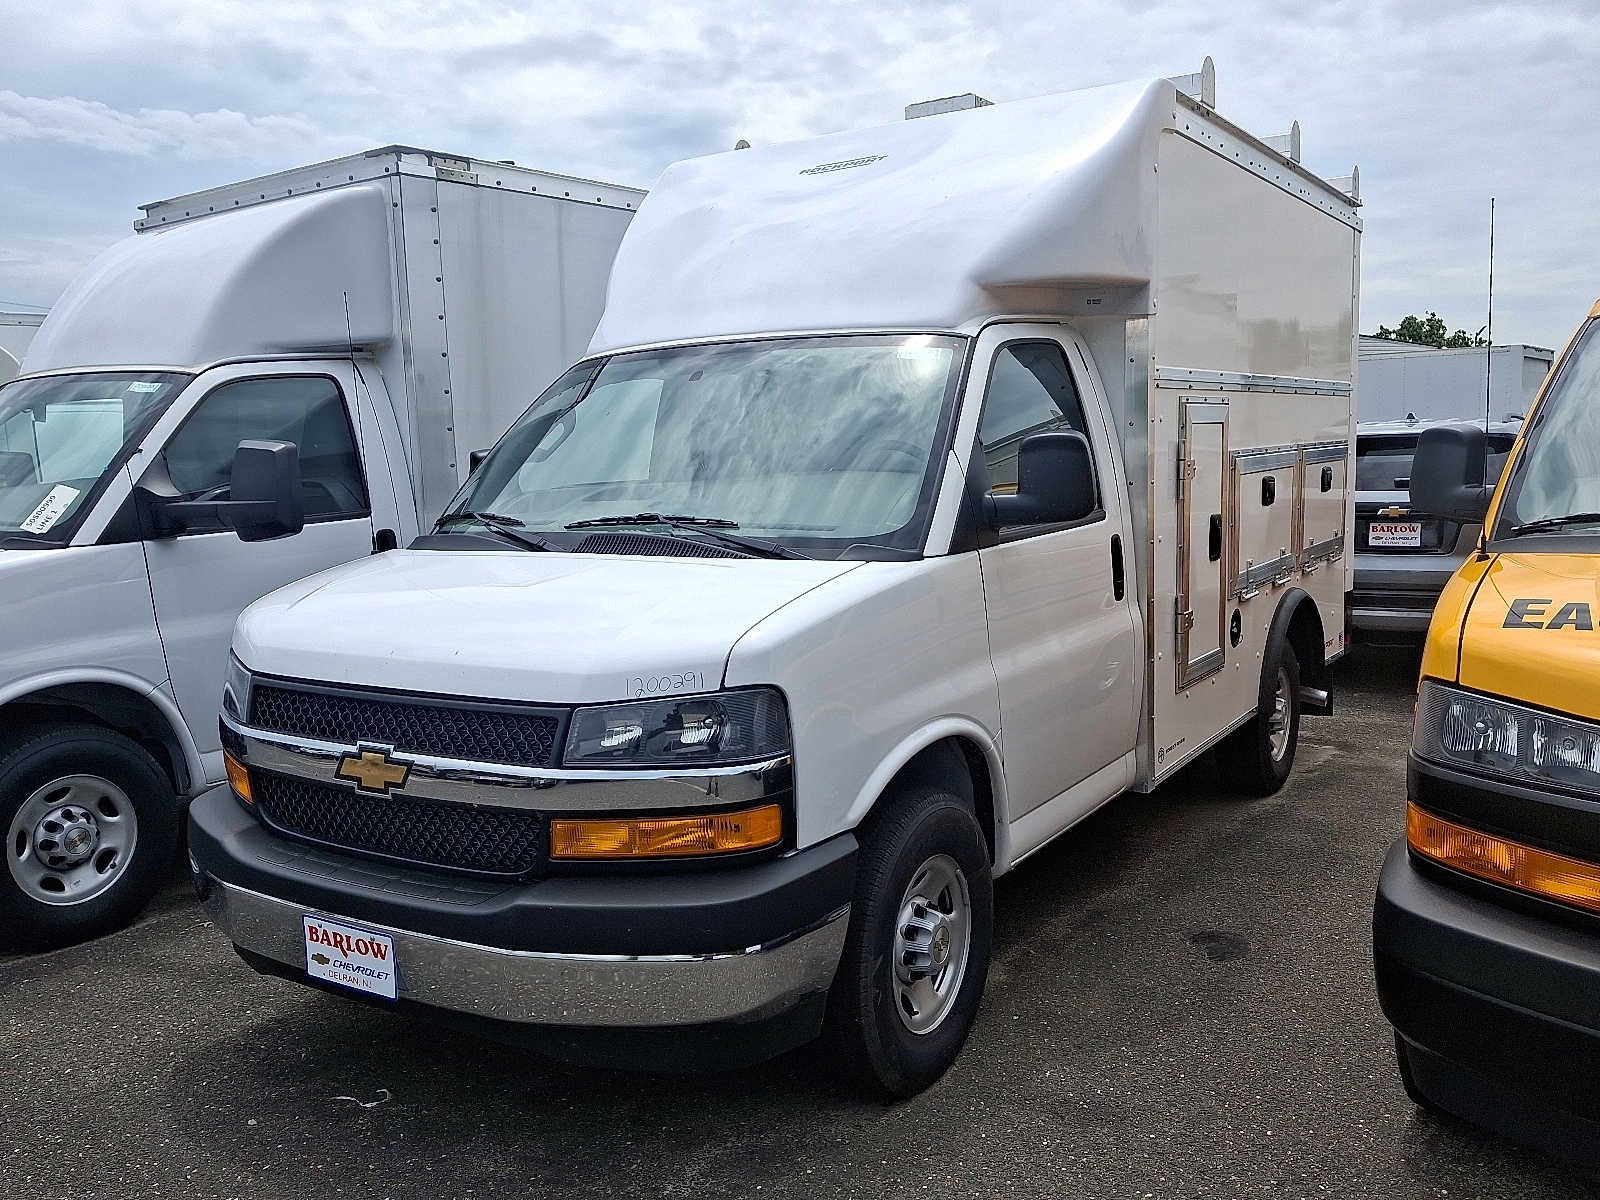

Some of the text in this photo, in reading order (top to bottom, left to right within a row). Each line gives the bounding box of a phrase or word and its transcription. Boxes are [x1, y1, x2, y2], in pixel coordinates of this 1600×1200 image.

[1371, 525, 1419, 535] BARLOW
[1502, 598, 1600, 631] EA
[626, 672, 704, 698] 1200291
[307, 924, 389, 961] BARLOW
[328, 969, 361, 987] DELRAN,
[332, 959, 391, 981] CHEVROLET
